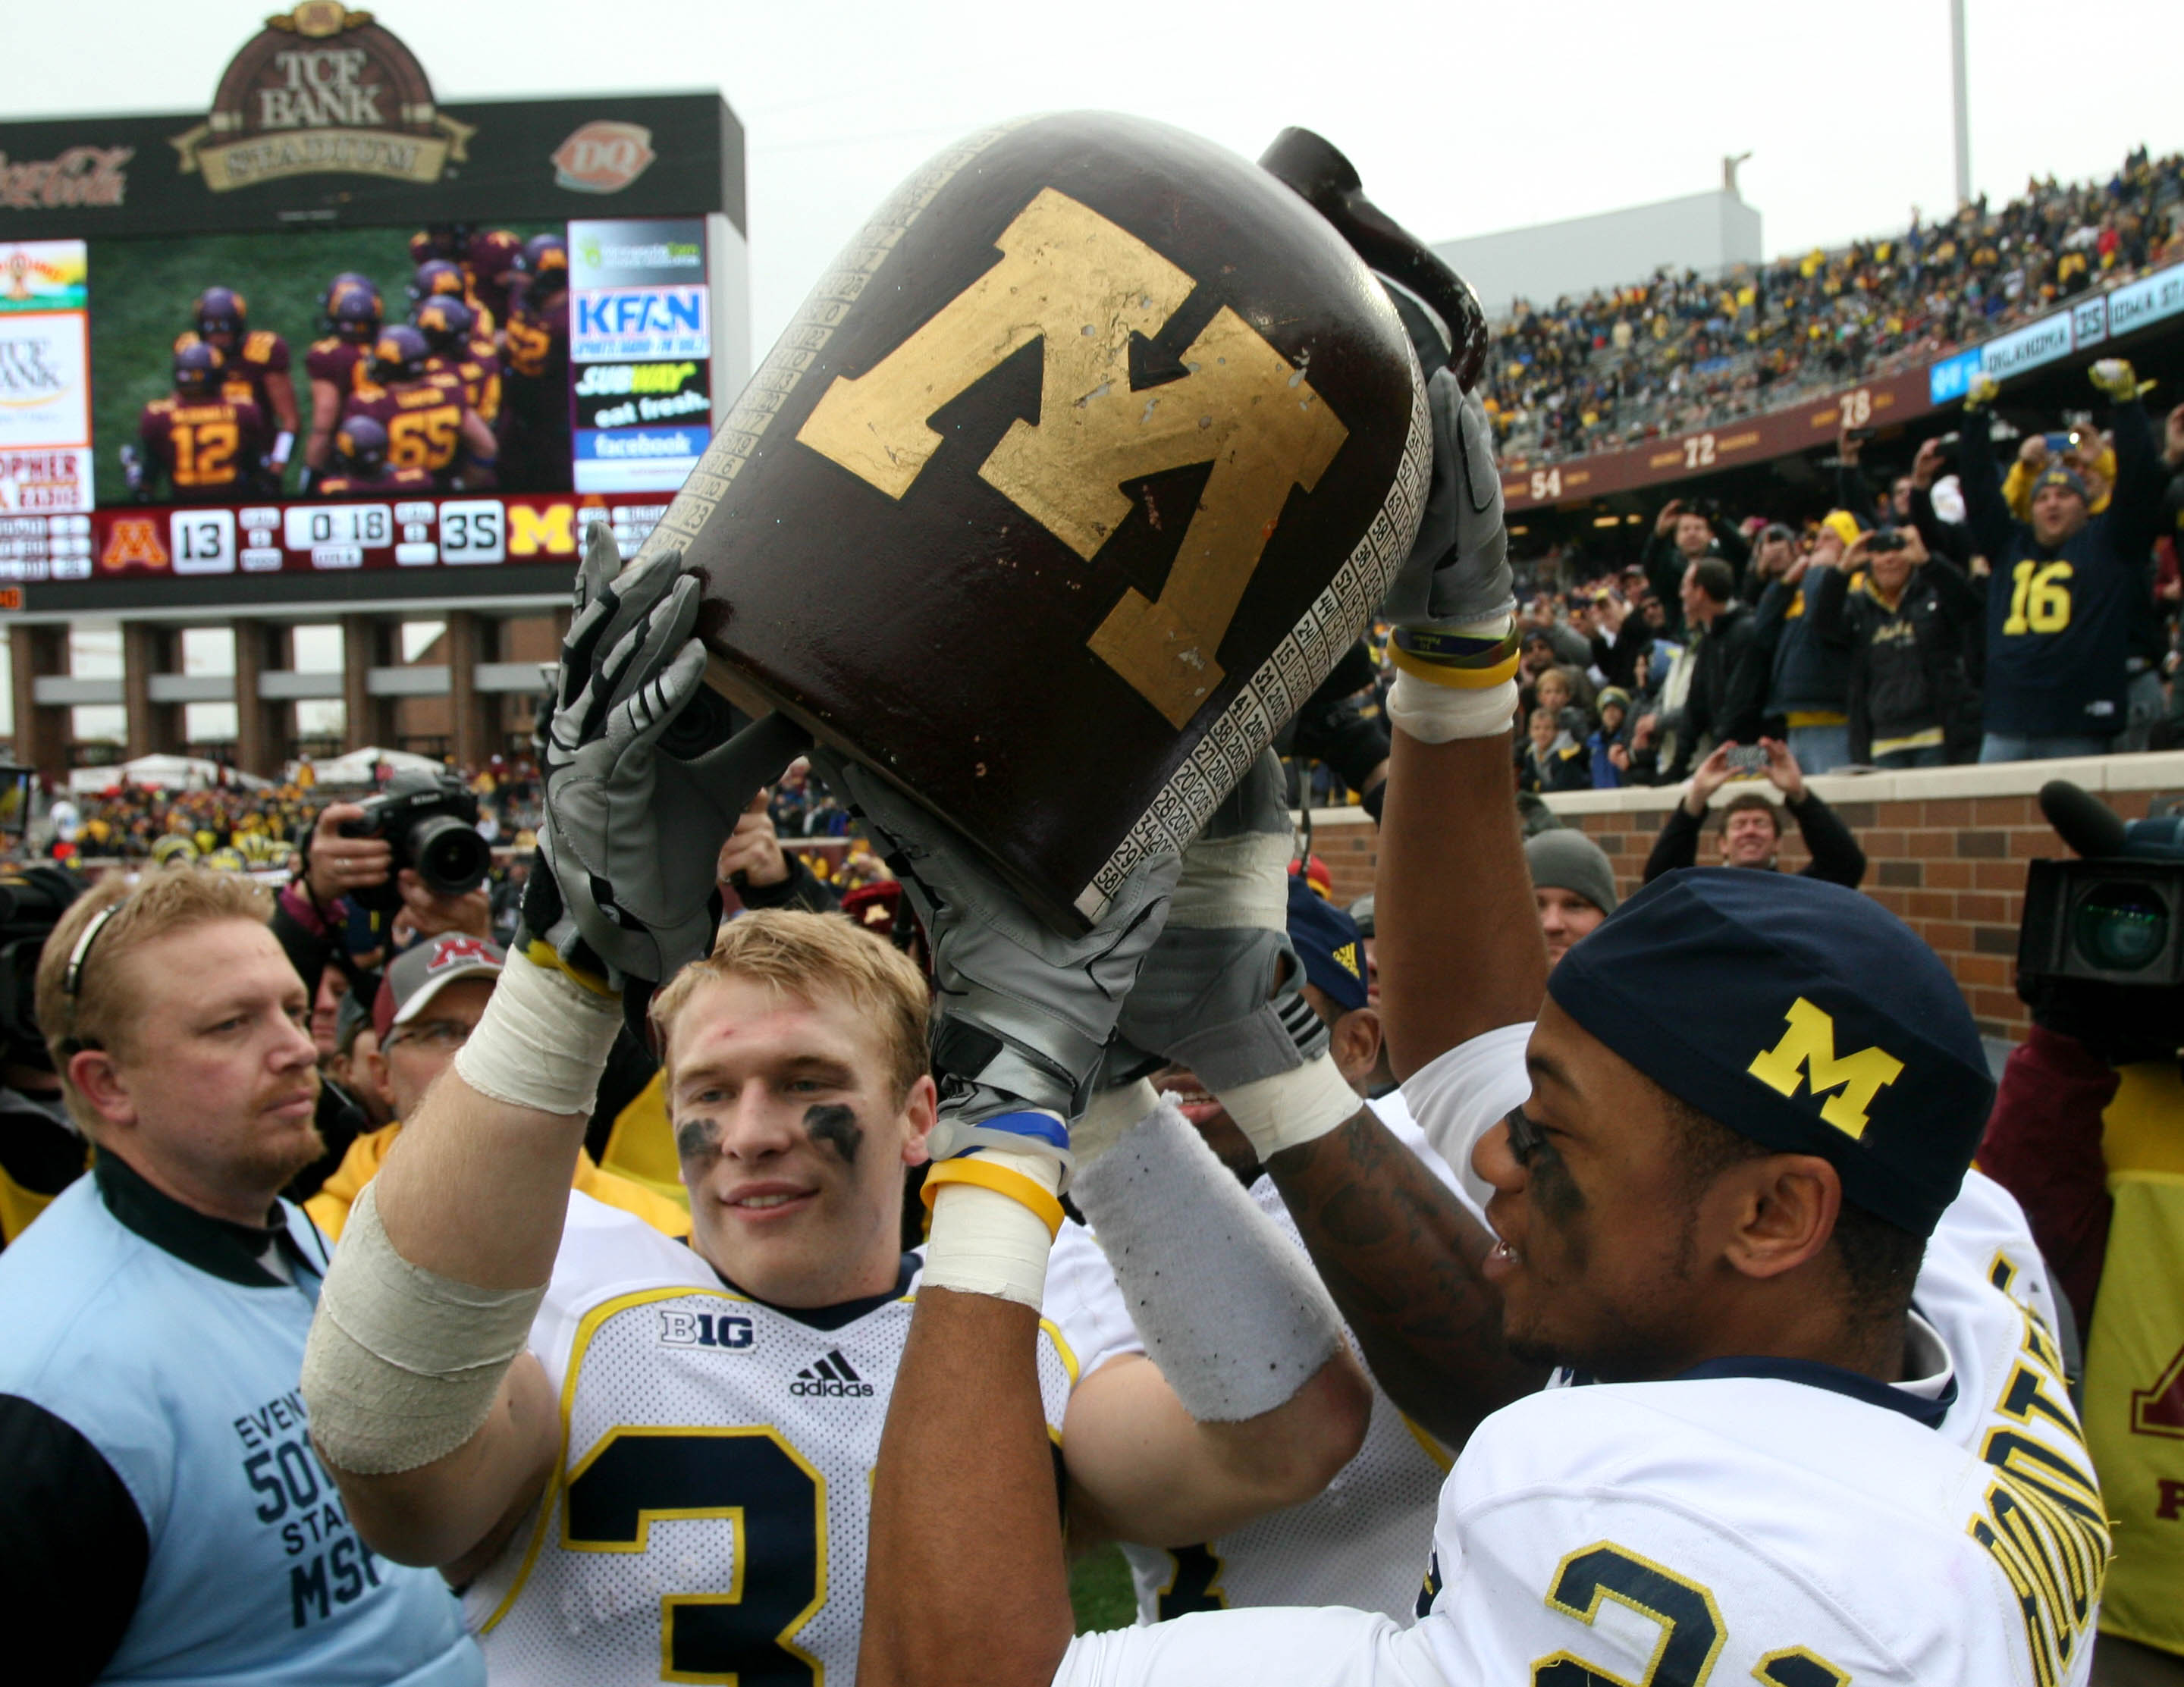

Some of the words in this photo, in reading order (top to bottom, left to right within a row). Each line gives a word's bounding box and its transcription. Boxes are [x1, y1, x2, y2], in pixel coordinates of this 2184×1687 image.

[276, 49, 366, 86] TCF
[259, 83, 385, 130] BANK
[227, 139, 418, 176] STADIUM
[572, 140, 635, 175] DQ
[579, 293, 700, 334] KFAN
[171, 422, 240, 486] 12
[594, 431, 691, 456] facebook
[795, 187, 1349, 731] M
[1683, 433, 1716, 469] 72
[1400, 459, 1413, 489] 52
[1531, 467, 1561, 501] 54
[684, 503, 710, 530] 23
[1388, 491, 1402, 516] 63
[183, 522, 221, 560] 13
[445, 513, 497, 550] 35
[508, 504, 576, 556] M
[1373, 516, 1389, 542] 58
[1335, 569, 1353, 597] 52
[2003, 560, 2074, 636] 16
[1317, 594, 1336, 621] 44
[1298, 618, 1315, 644] 24
[1276, 641, 1295, 666] 15
[1255, 665, 1273, 695] 31
[1231, 694, 1252, 721] 41
[1213, 717, 1233, 742] 38
[1225, 735, 1249, 771] 2003
[1194, 740, 1216, 766] 27
[1207, 758, 1232, 790] 2004
[1174, 764, 1197, 792] 20
[1188, 782, 1213, 817] 2005
[1153, 789, 1177, 818] 28
[1168, 806, 1195, 842] 2006
[1134, 815, 1158, 844] 34
[1148, 833, 1175, 854] 200
[1113, 841, 1138, 869] 29
[1097, 867, 1119, 889] 58
[1747, 996, 1905, 1140] M
[789, 1378, 874, 1398] adidas
[233, 1388, 307, 1450] EVEN
[281, 1494, 350, 1556] STA
[560, 1425, 876, 1687] 3
